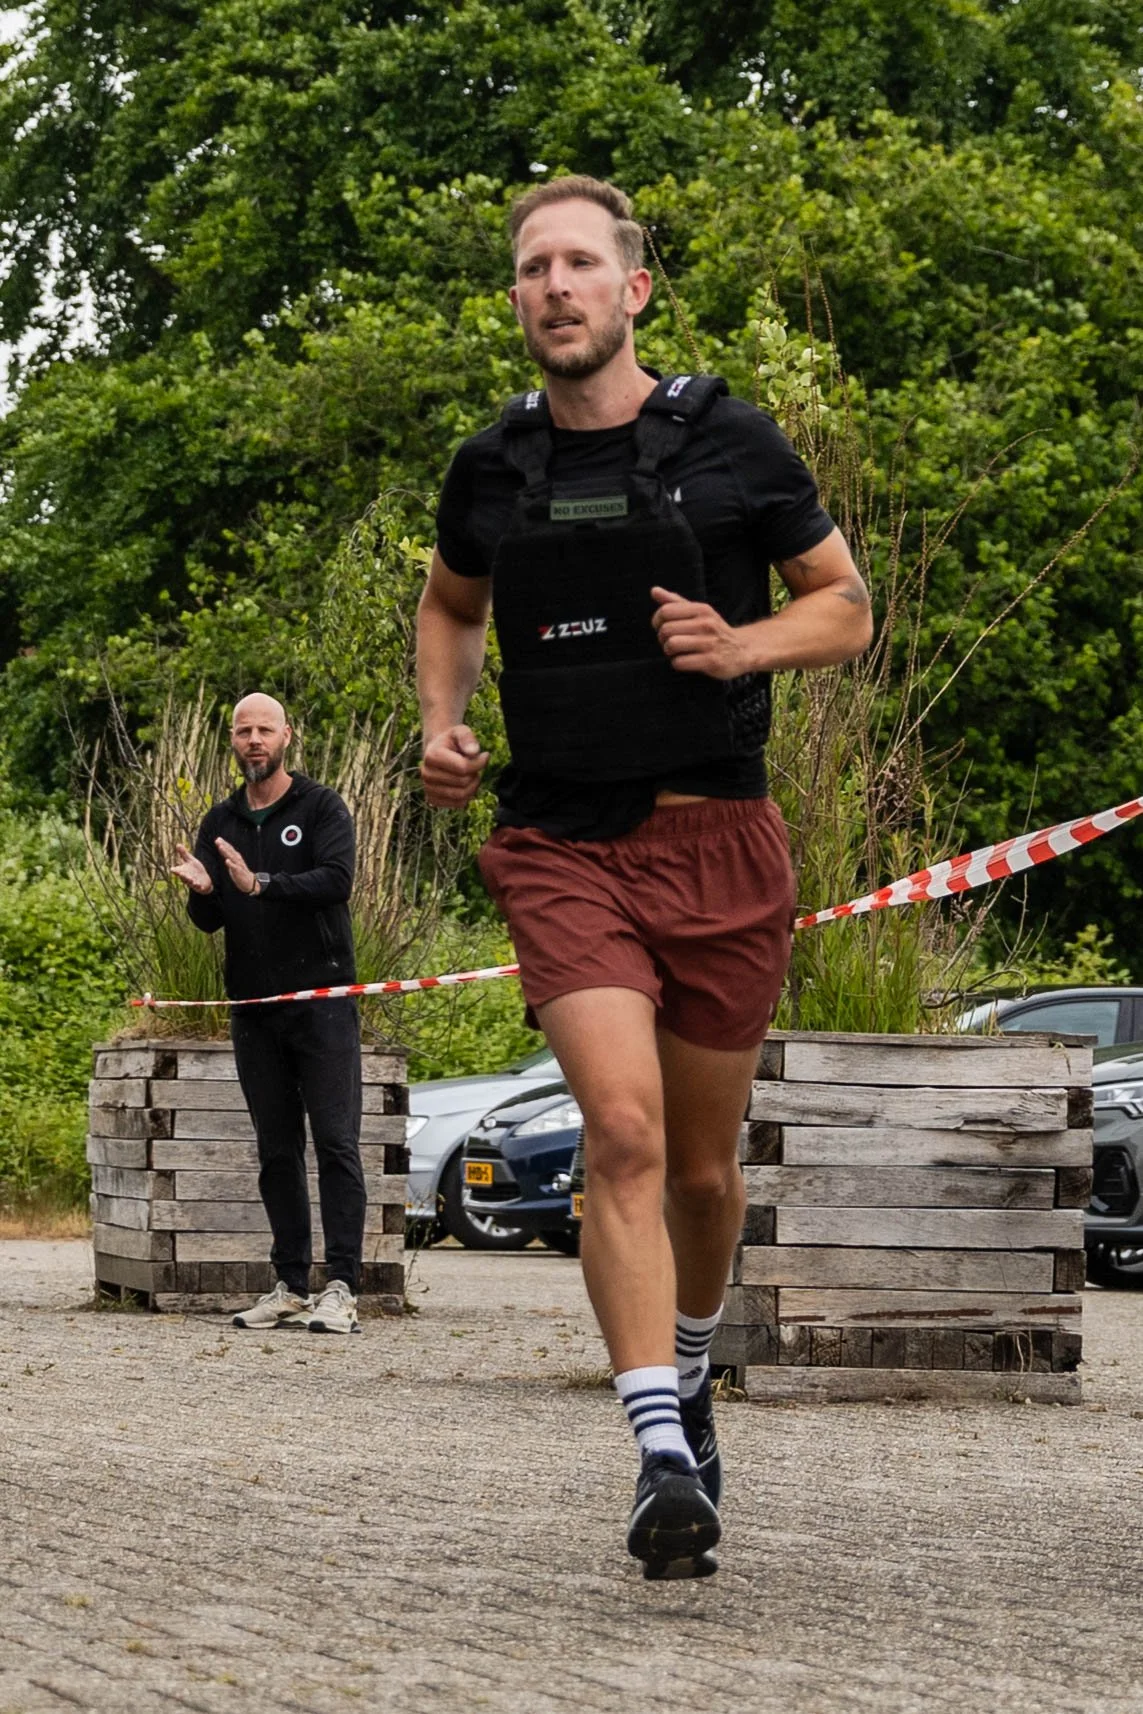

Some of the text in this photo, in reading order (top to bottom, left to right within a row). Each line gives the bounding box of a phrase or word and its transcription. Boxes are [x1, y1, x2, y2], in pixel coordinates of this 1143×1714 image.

[554, 502, 625, 516] NO EXCUSES
[558, 618, 608, 638] ZEUZ
